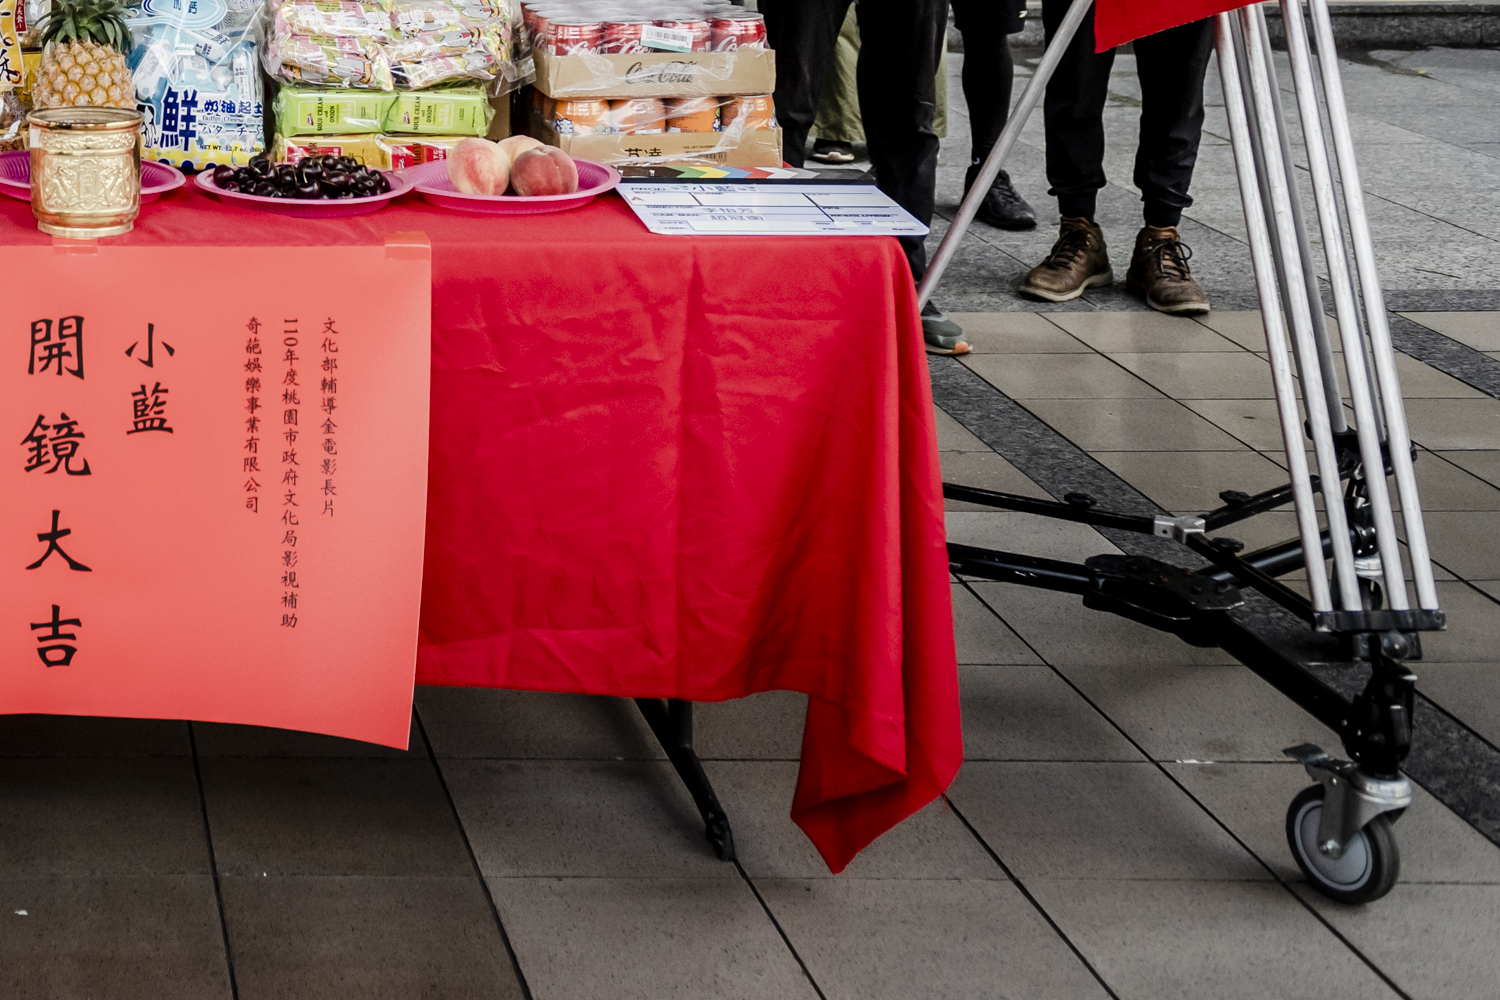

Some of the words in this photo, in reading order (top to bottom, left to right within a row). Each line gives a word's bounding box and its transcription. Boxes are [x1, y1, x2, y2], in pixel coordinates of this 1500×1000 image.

[159, 86, 198, 152] 鮮
[316, 96, 324, 115] CREAM
[412, 114, 420, 131] SOUR
[413, 95, 421, 114] CREAM
[124, 322, 175, 435] 小藍
[243, 316, 263, 514] 奇葩娛樂事業有限公司
[320, 316, 339, 518] 文化部輔導金電影長片
[19, 315, 93, 668] 開鏡大吉
